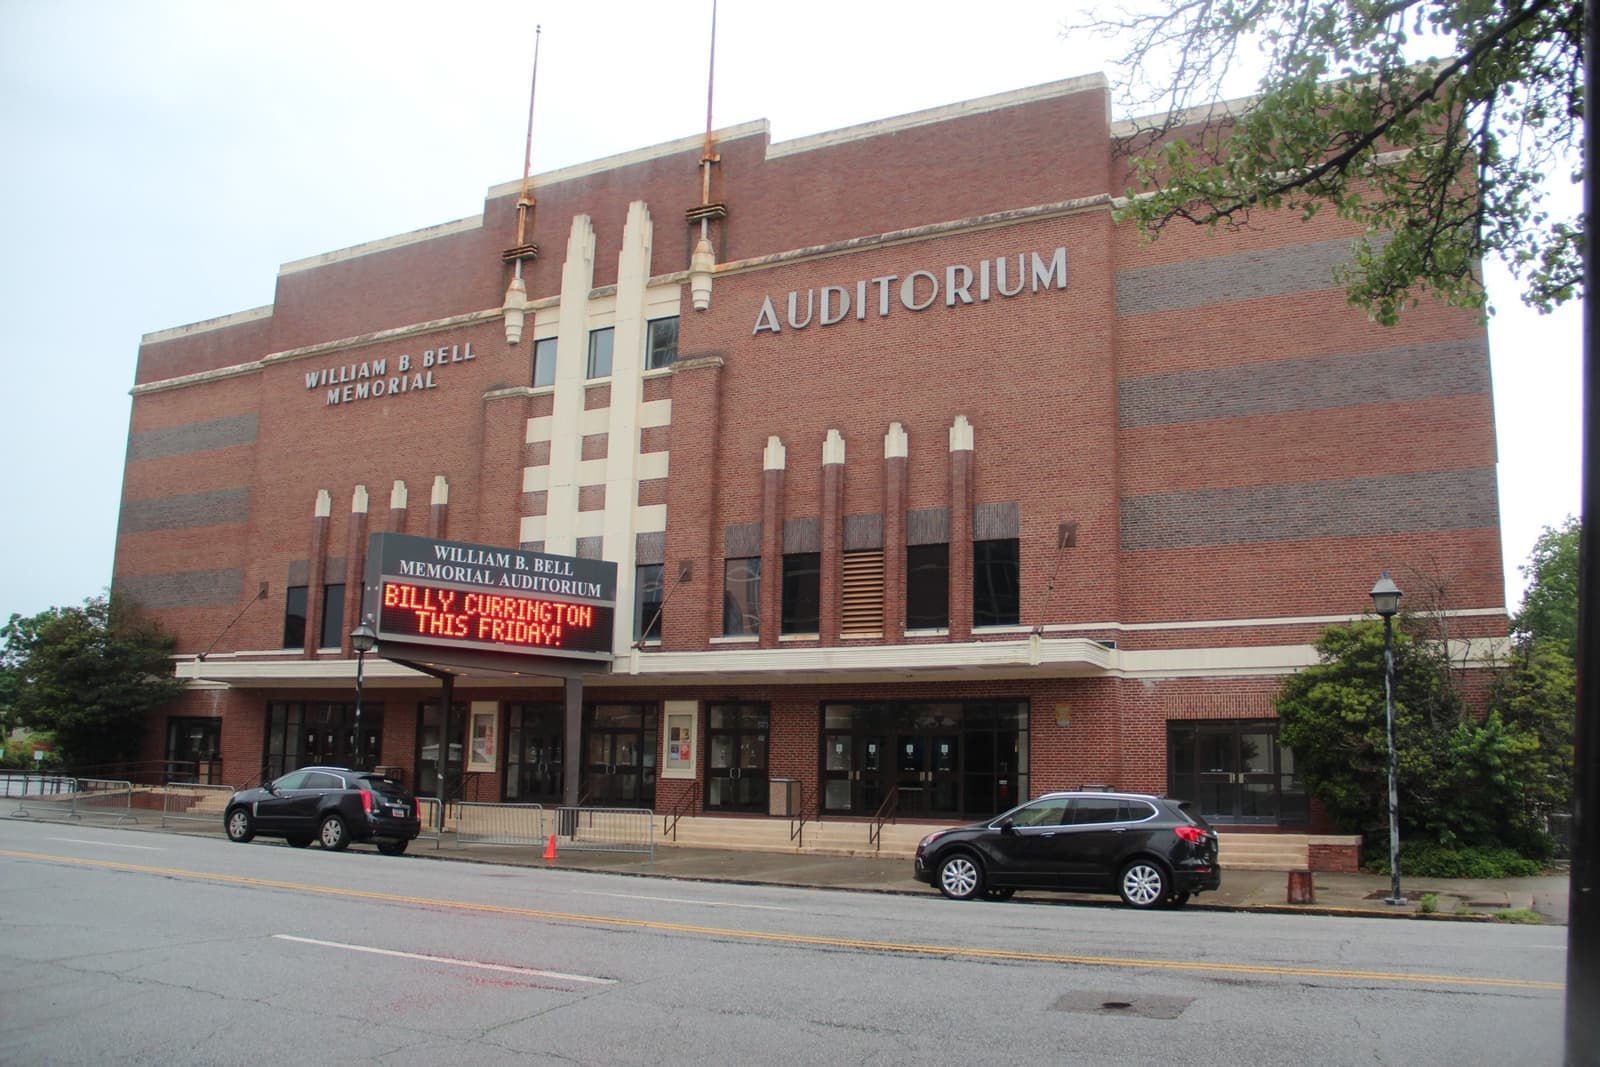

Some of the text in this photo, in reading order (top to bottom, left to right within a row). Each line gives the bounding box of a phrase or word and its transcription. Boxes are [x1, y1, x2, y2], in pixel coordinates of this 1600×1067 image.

[752, 247, 1067, 335] AUDITORIUM
[305, 358, 386, 389] WILLIAM
[423, 342, 476, 368] BELL
[326, 371, 437, 406] MEMORIAL
[400, 560, 601, 598] MEMORIAL AUDITORIUM
[434, 545, 574, 576] WILLIAM B. BELL
[384, 584, 592, 628] BILLY CURRINGTON
[415, 610, 562, 646] THIS FRIDAY!
